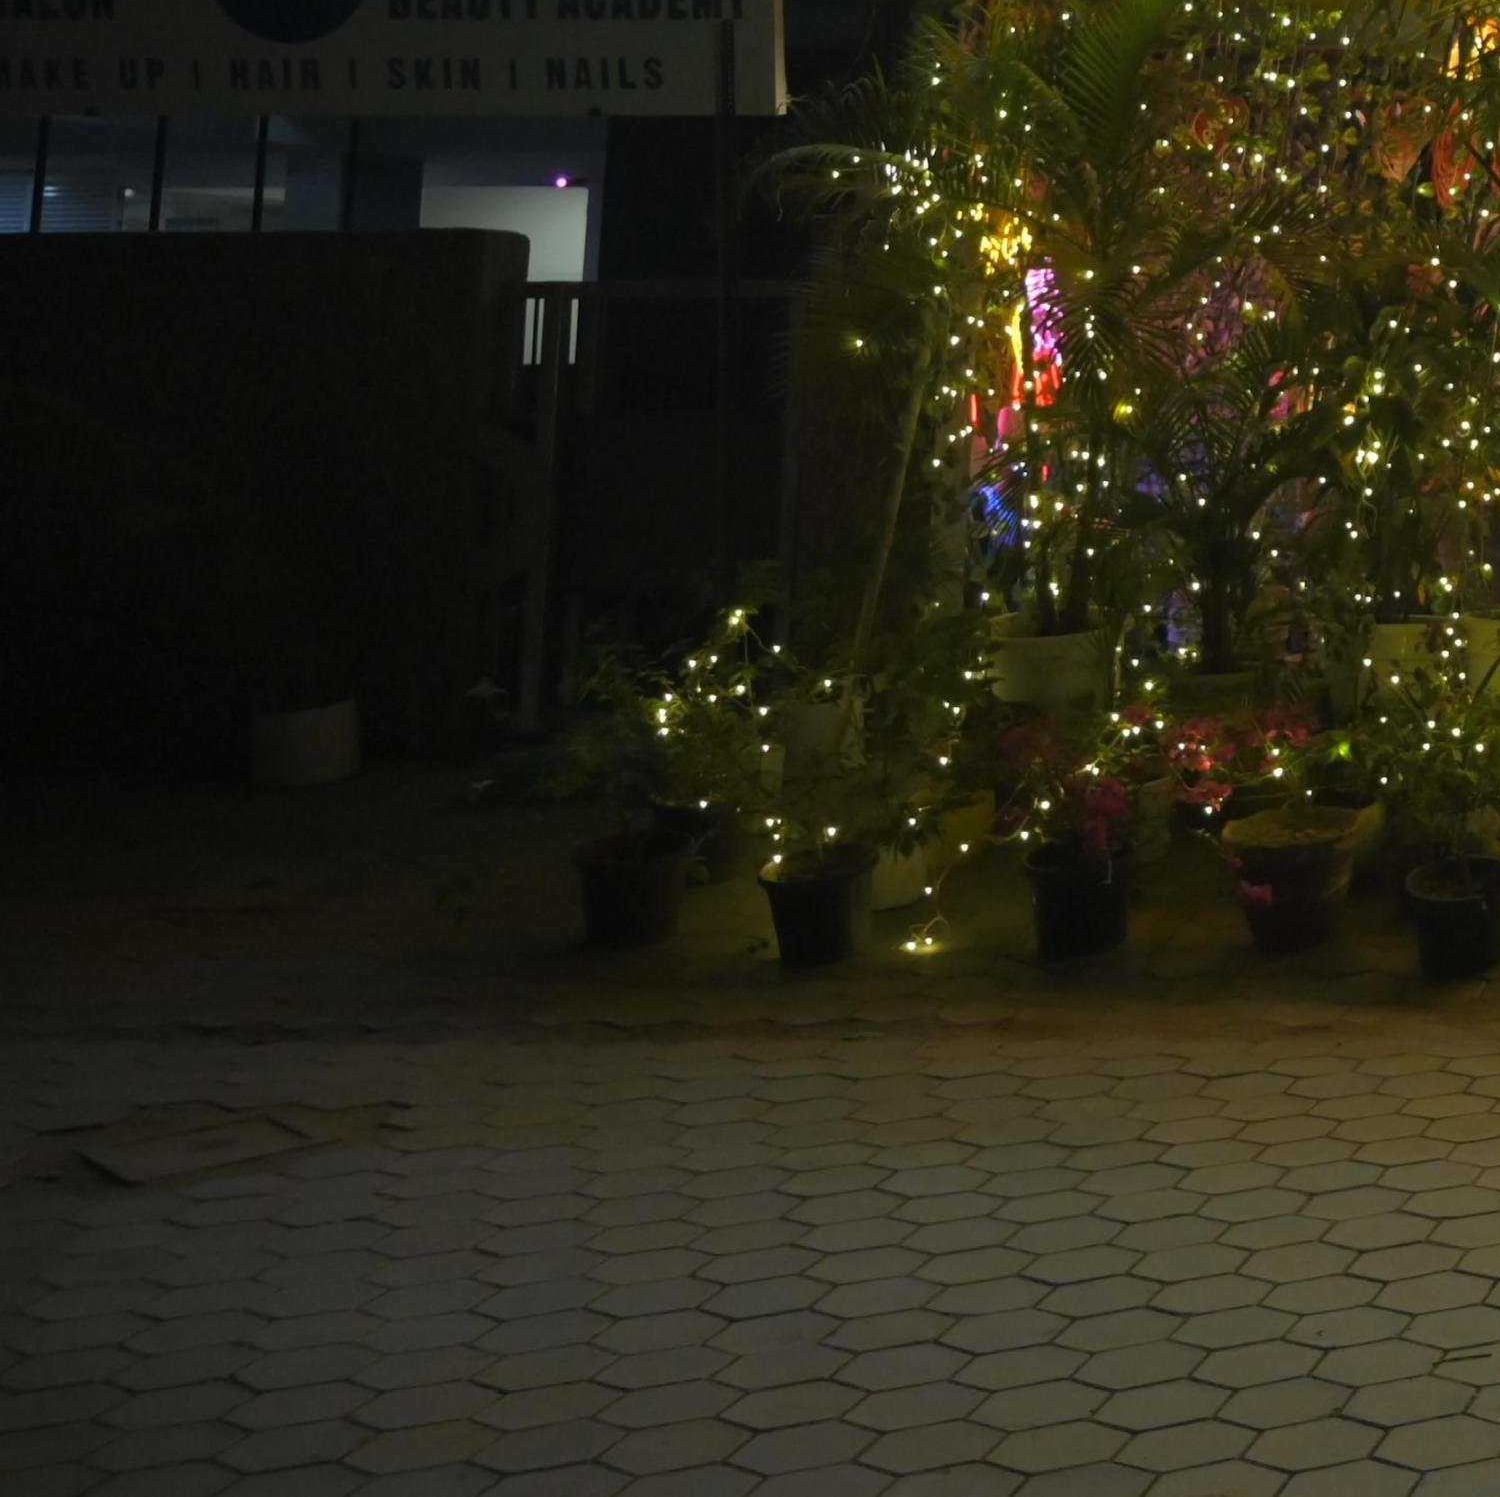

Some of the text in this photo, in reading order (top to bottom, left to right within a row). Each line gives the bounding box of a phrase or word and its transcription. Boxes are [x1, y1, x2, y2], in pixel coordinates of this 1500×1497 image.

[117, 56, 166, 91] UP
[228, 56, 321, 91] HAIR
[386, 56, 482, 91] SKIN
[545, 56, 664, 91] NAILS
